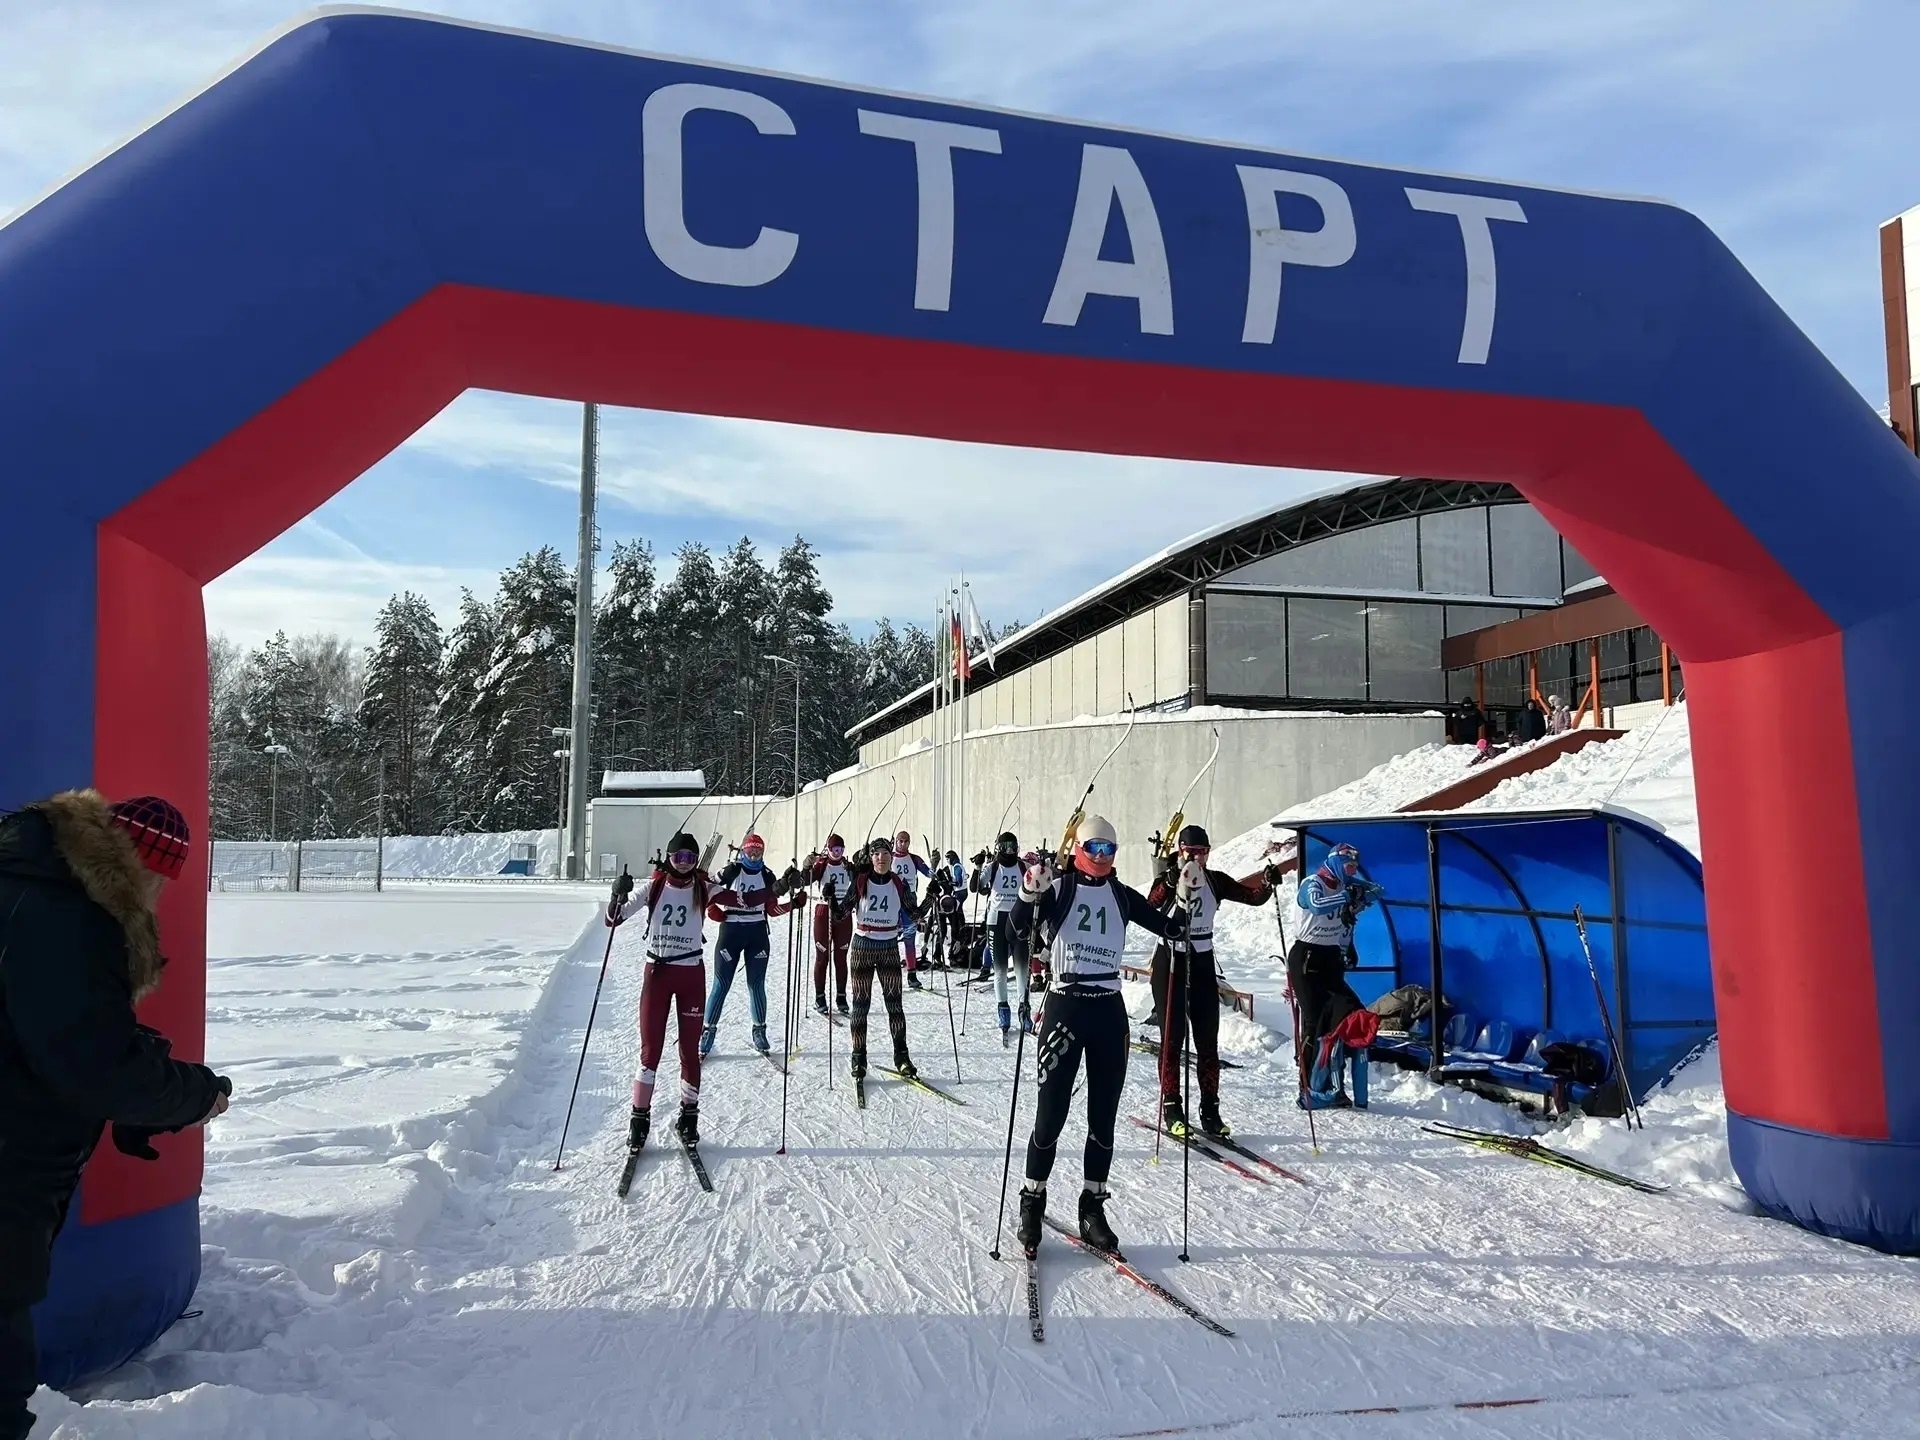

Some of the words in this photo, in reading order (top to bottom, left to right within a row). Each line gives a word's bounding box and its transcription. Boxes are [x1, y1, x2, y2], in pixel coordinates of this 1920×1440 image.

[643, 83, 1527, 365] СТАРТ
[896, 864, 909, 874] 28
[830, 873, 845, 884] 27
[1002, 875, 1018, 889] 25
[868, 895, 888, 912] 24
[662, 904, 687, 927] 23
[1077, 904, 1107, 935] 21
[1482, 1140, 1530, 1158] FISCHER
[1027, 1282, 1040, 1321] ROSSIGNOL
